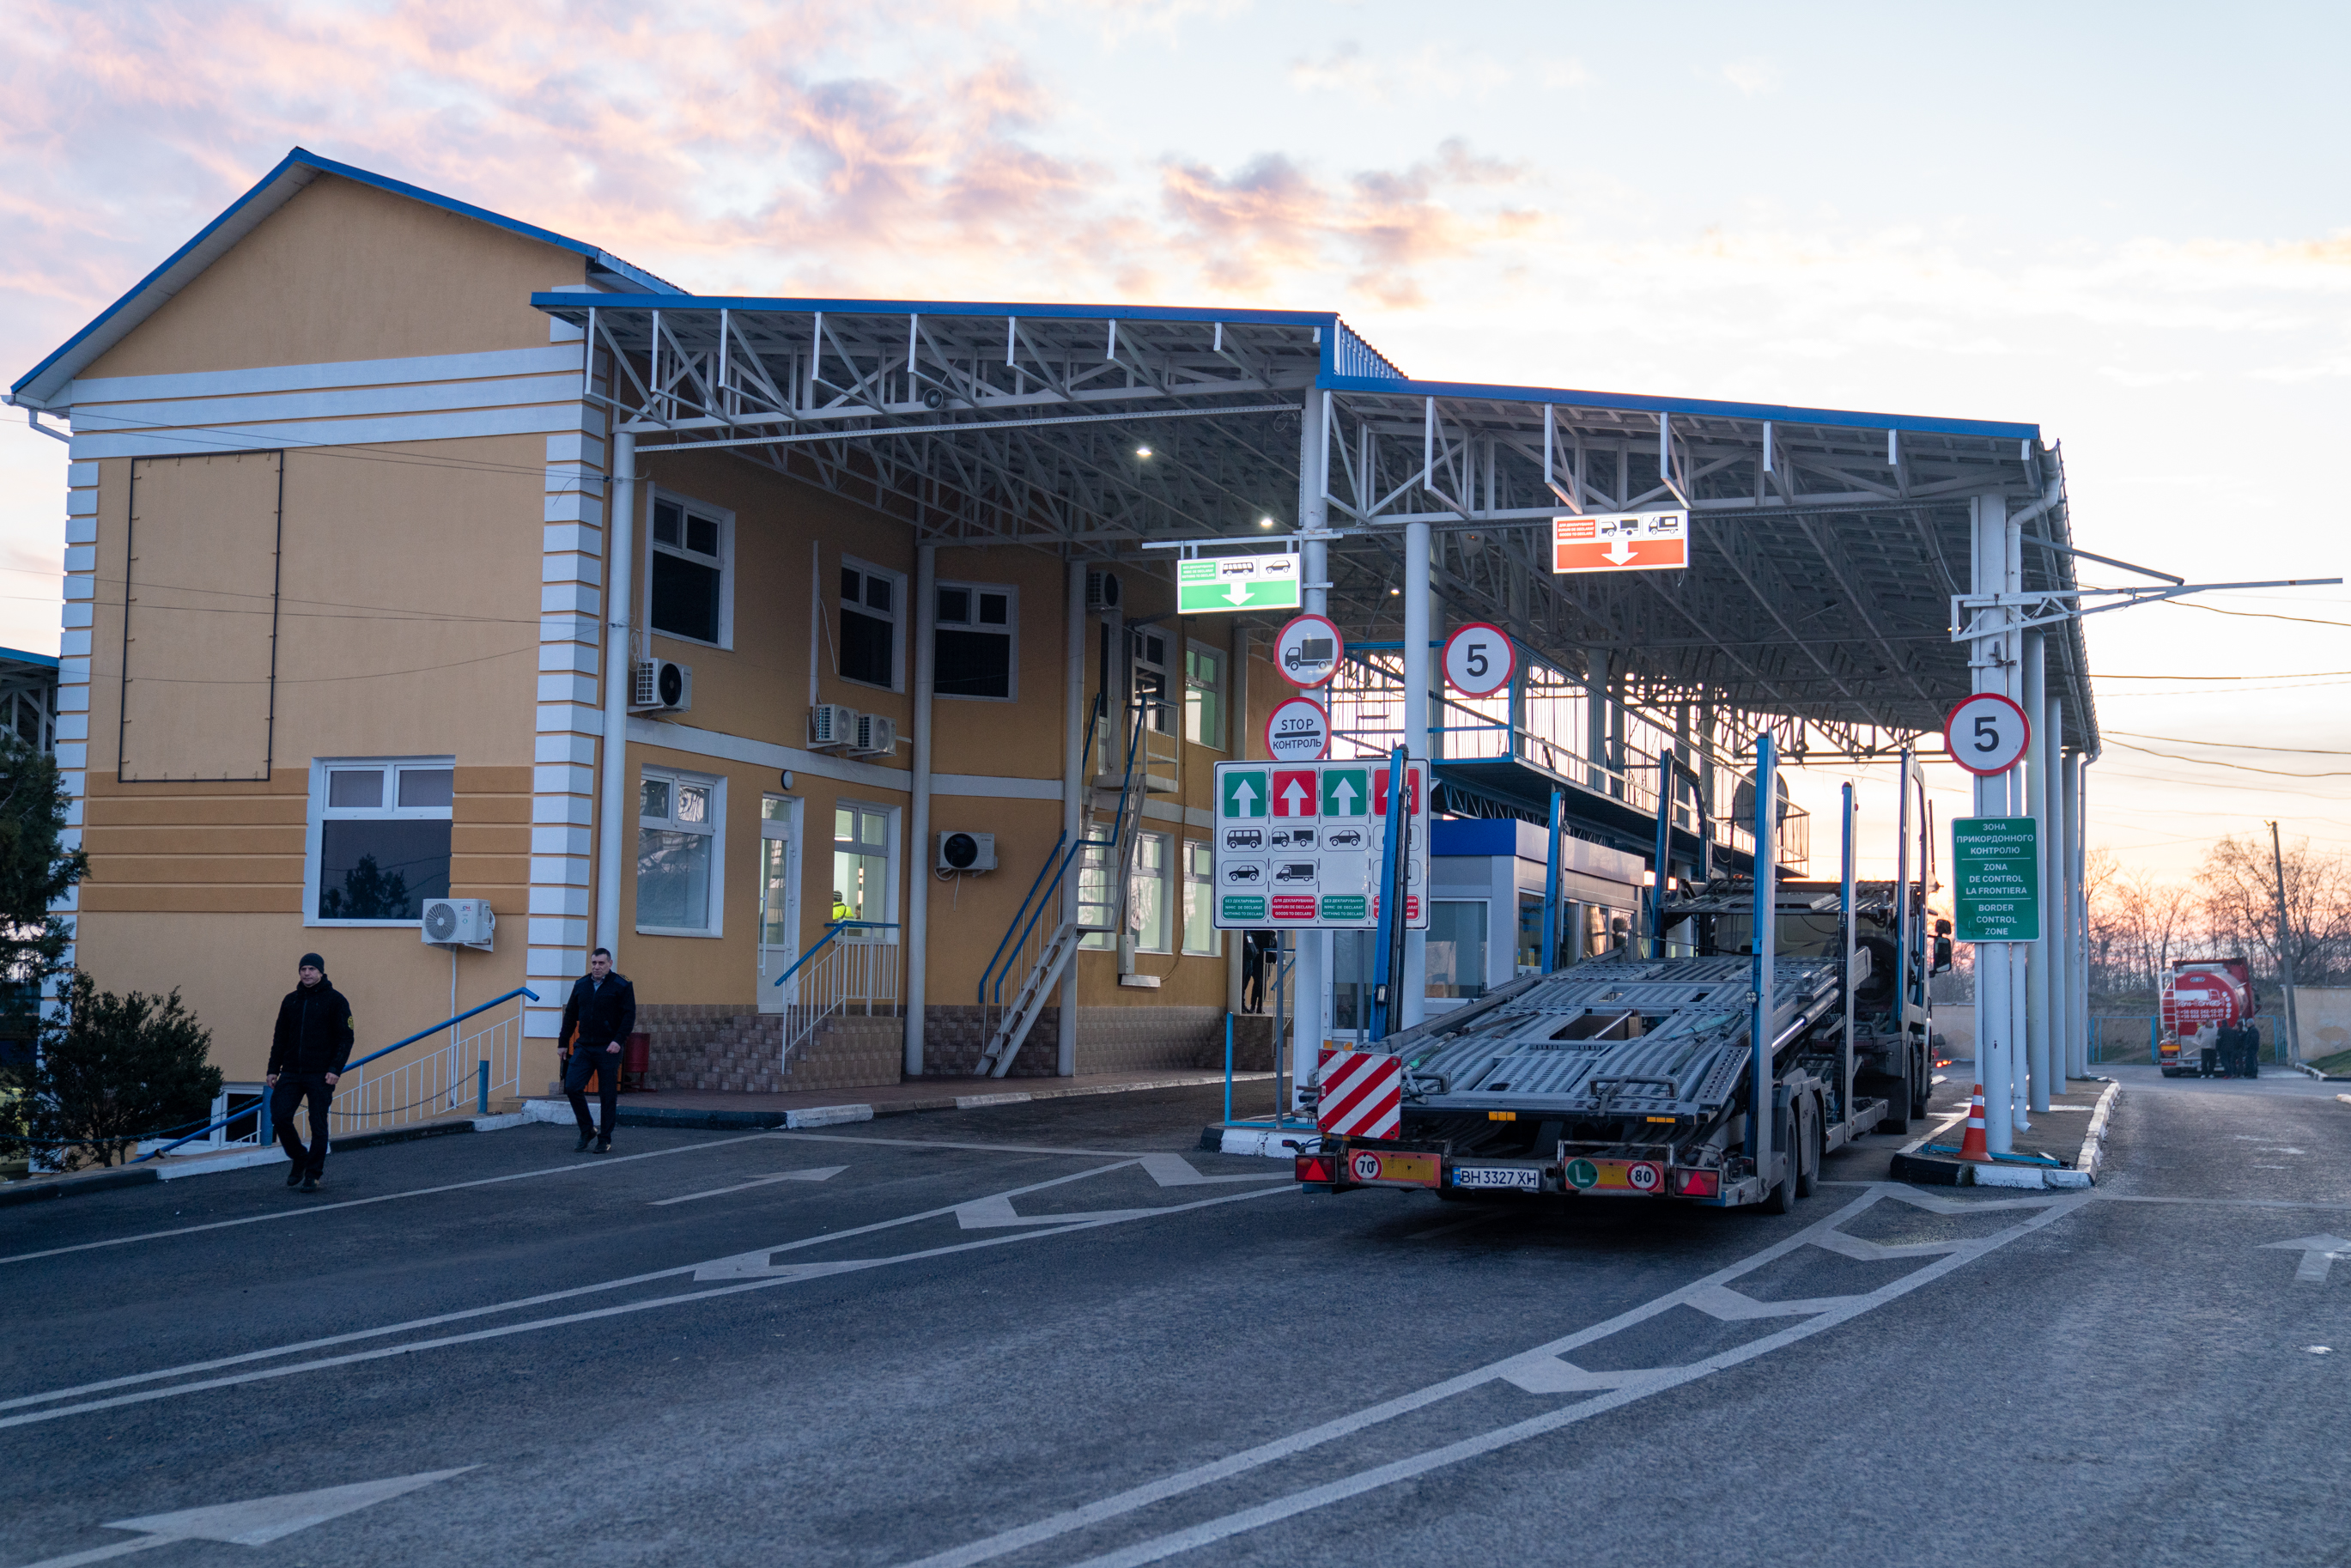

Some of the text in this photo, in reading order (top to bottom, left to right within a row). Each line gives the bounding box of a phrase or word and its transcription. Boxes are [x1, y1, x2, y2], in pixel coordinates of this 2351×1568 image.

[1466, 643, 1488, 678] 5
[1281, 719, 1314, 731] STOP
[1974, 716, 1999, 752] 5
[1273, 738, 1321, 750] КОНТРОЛЬ
[1956, 835, 2033, 843] ПРИКОРДОННОГО
[1359, 1161, 1375, 1173] 70
[1575, 1164, 1589, 1183] L
[1461, 1170, 1536, 1185] BH 3327 XH
[1635, 1170, 1652, 1183] 80
